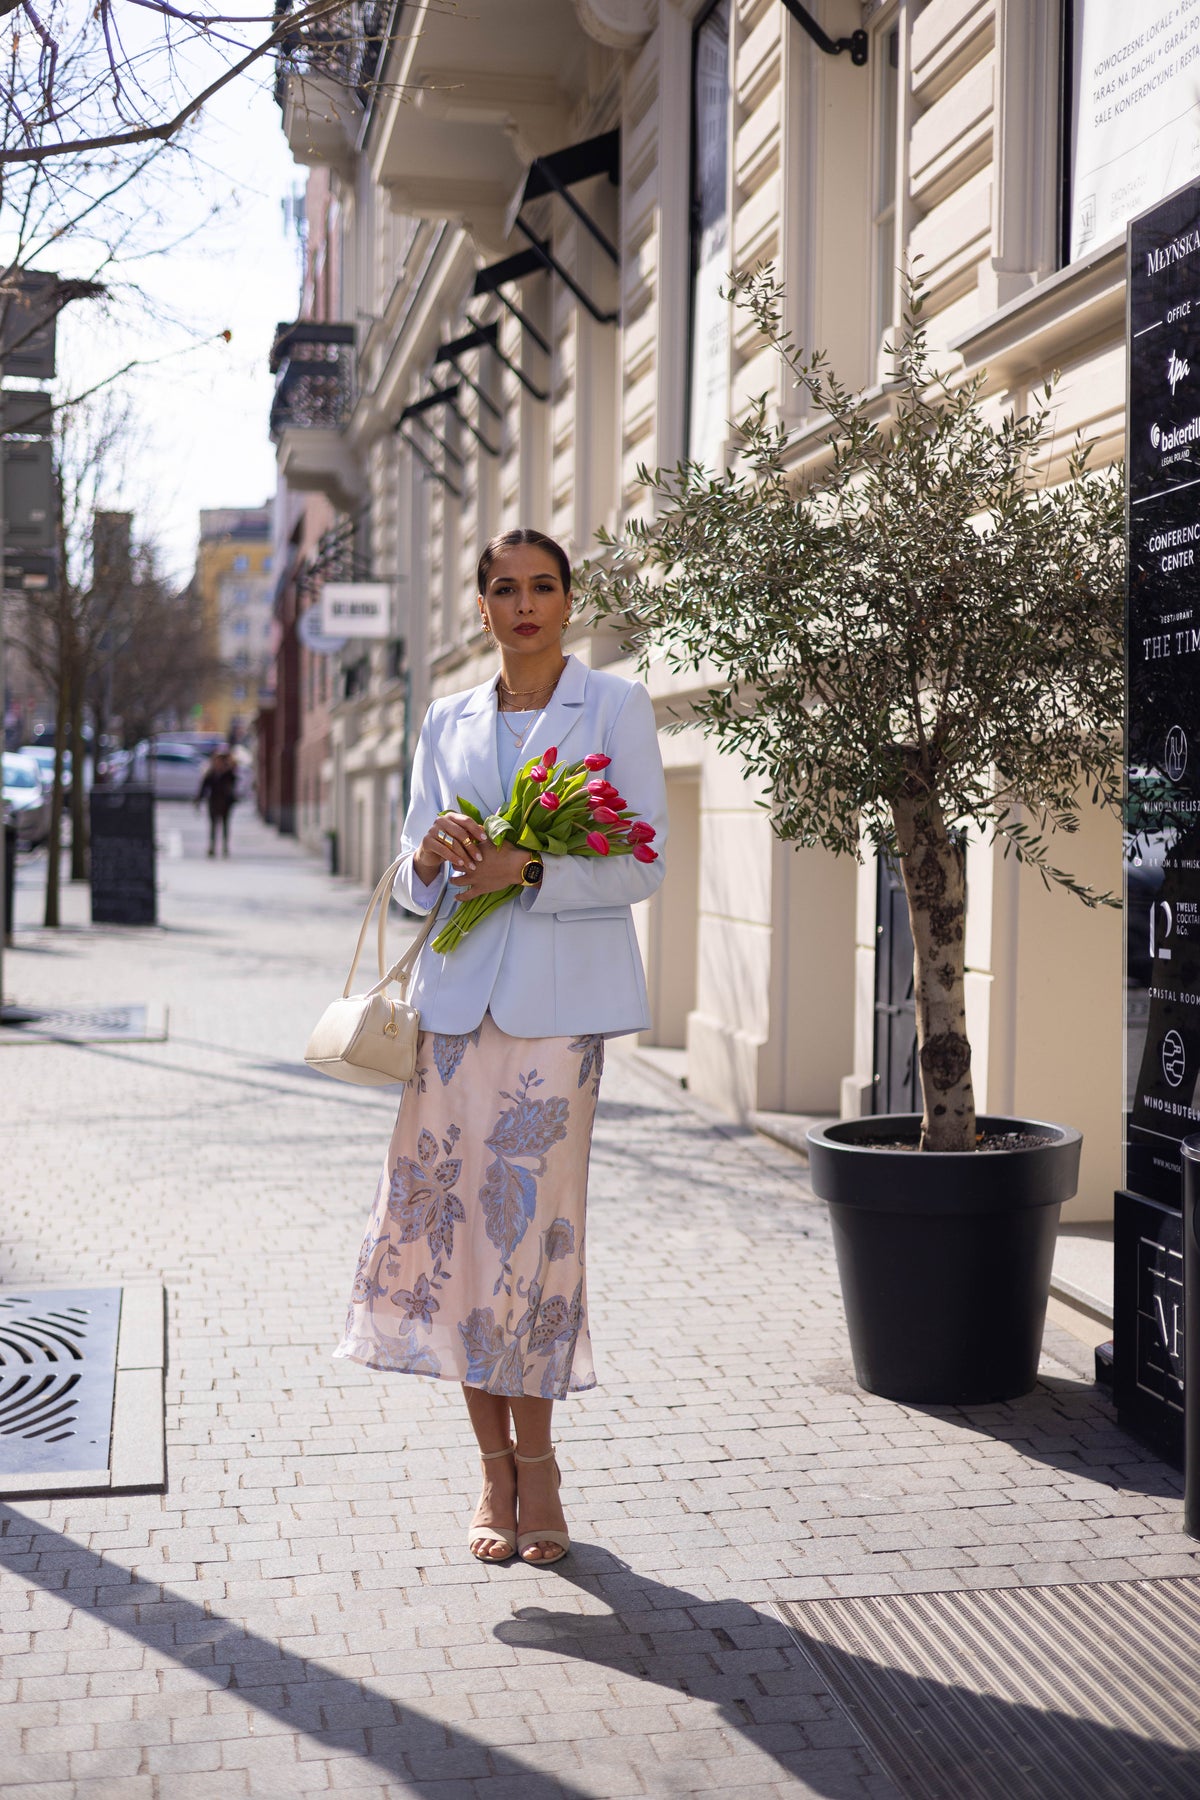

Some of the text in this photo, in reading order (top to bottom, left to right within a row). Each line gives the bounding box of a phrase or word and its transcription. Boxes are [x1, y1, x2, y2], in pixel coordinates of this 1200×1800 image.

[1094, 34, 1144, 79] NOWOCZESNE
[1146, 11, 1173, 42] LOKALE
[1093, 79, 1116, 104] TARAS
[1118, 72, 1129, 88] NA
[1131, 51, 1156, 80] DACHU
[1095, 107, 1112, 128] SALE
[1114, 64, 1174, 116] KONFERENCYJNE
[1167, 301, 1191, 323] OFFICE
[1161, 449, 1190, 467] LEGAL POLAND
[1149, 523, 1200, 553] CONFERENC
[1161, 549, 1194, 572] CENTER
[1143, 634, 1170, 660] THE
[1144, 801, 1163, 813] WINO
[1176, 902, 1198, 913] TWELVE
[1148, 987, 1177, 1002] CRISTAL
[1143, 1094, 1163, 1111] WINO
